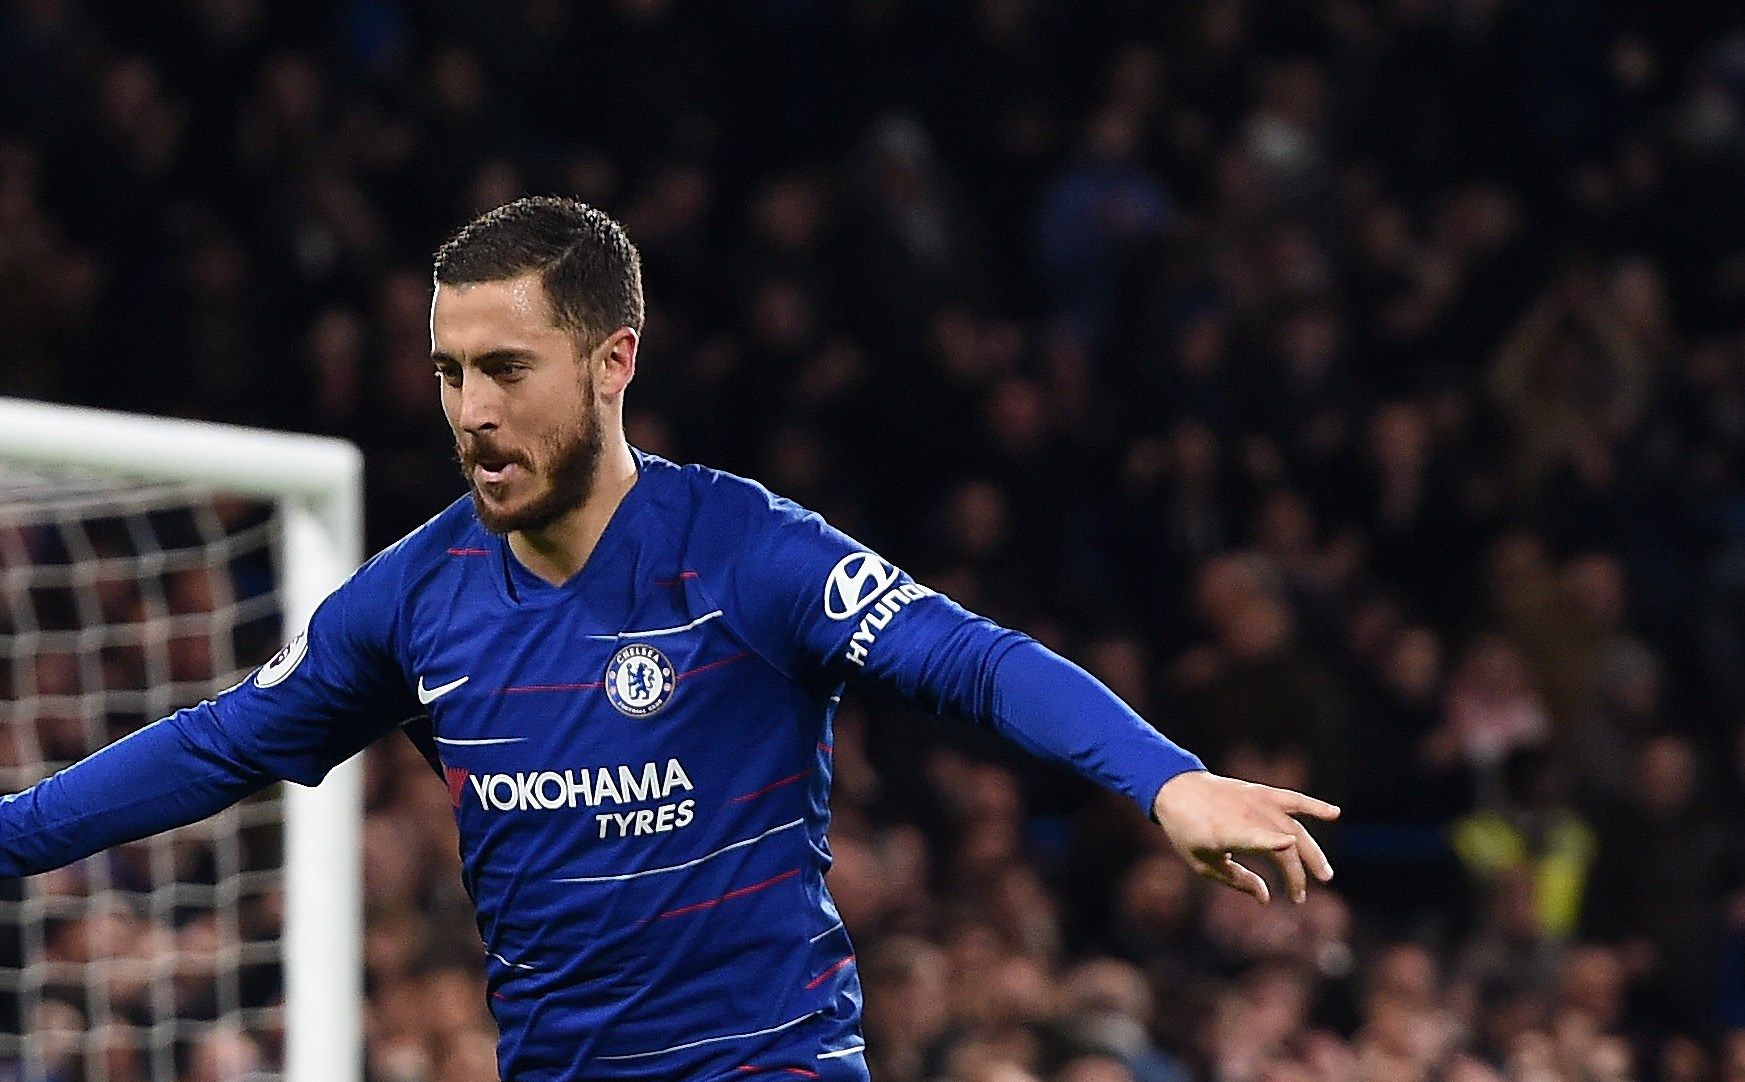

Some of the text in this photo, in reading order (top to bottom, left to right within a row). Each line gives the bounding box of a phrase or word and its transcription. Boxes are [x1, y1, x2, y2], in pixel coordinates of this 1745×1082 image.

[845, 582, 937, 667] HYUND
[616, 647, 660, 664] CHELSEA
[469, 758, 694, 811] YOKOHAMA
[595, 799, 695, 839] TYRES
